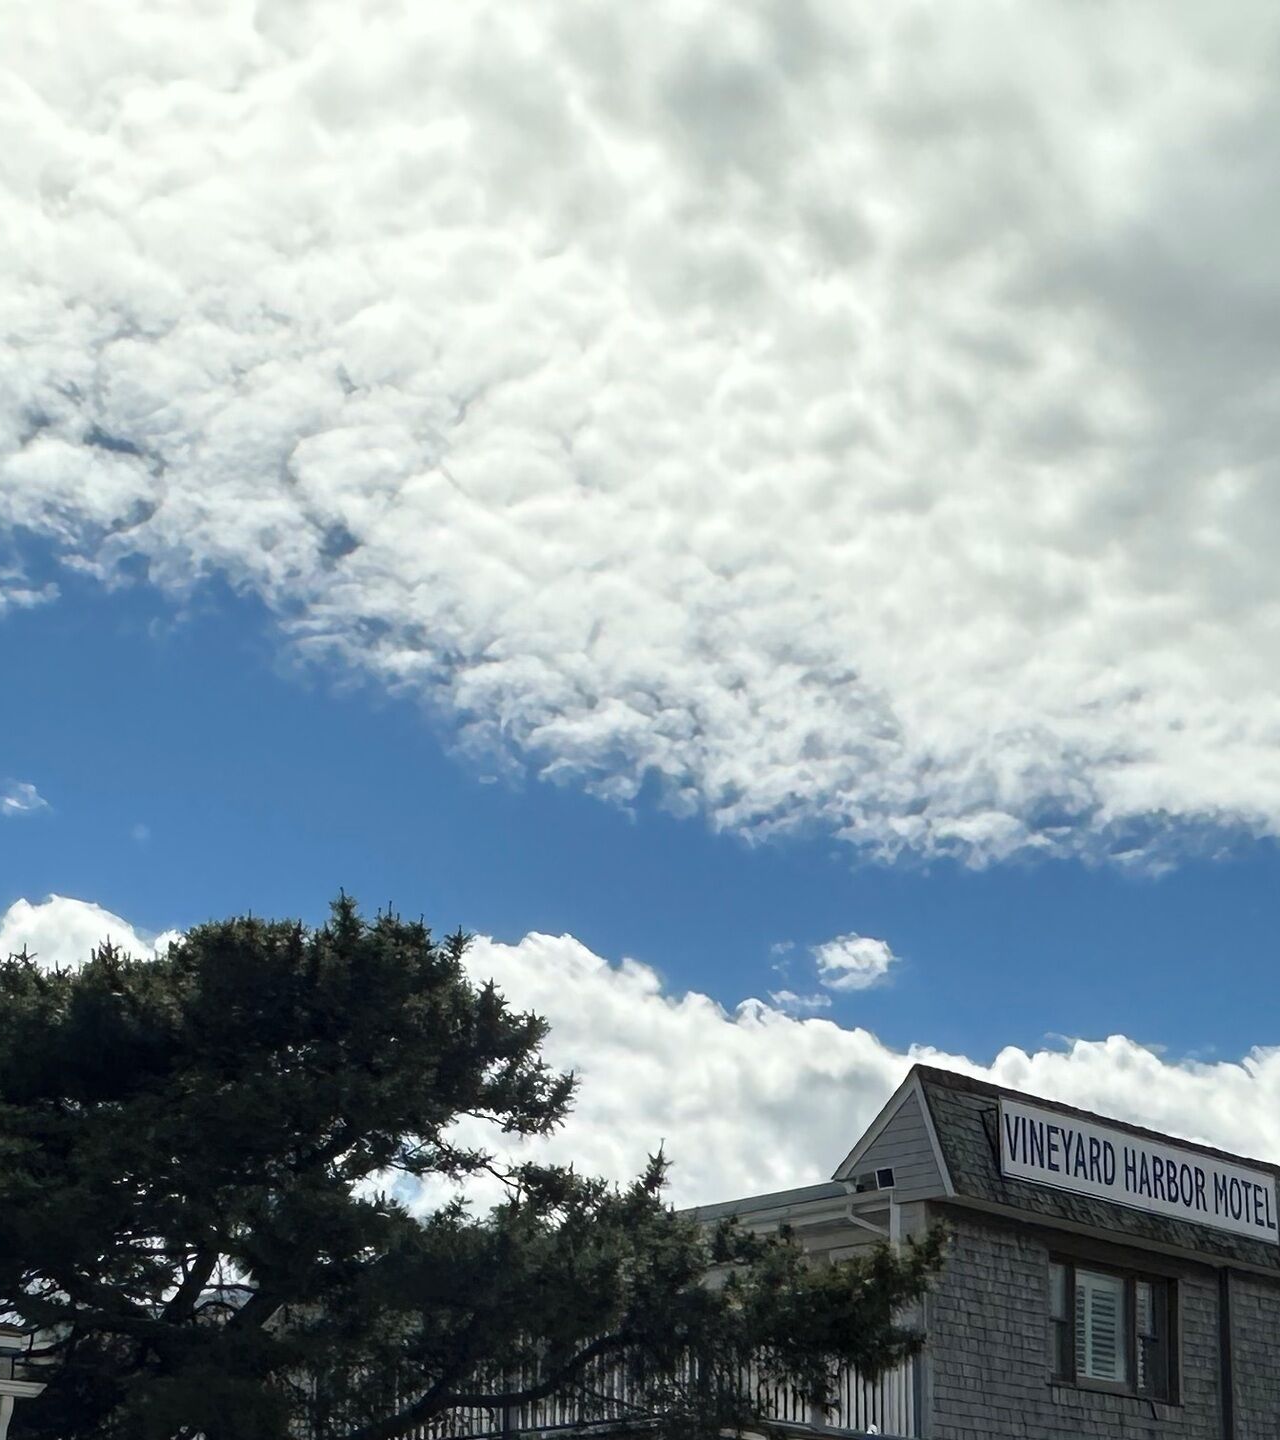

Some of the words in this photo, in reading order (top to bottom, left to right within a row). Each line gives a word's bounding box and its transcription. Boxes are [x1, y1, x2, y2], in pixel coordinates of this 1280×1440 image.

[1004, 1113, 1116, 1186] VINEYARD
[1124, 1146, 1208, 1212] HARBOR
[1214, 1172, 1276, 1230] MOTEL
